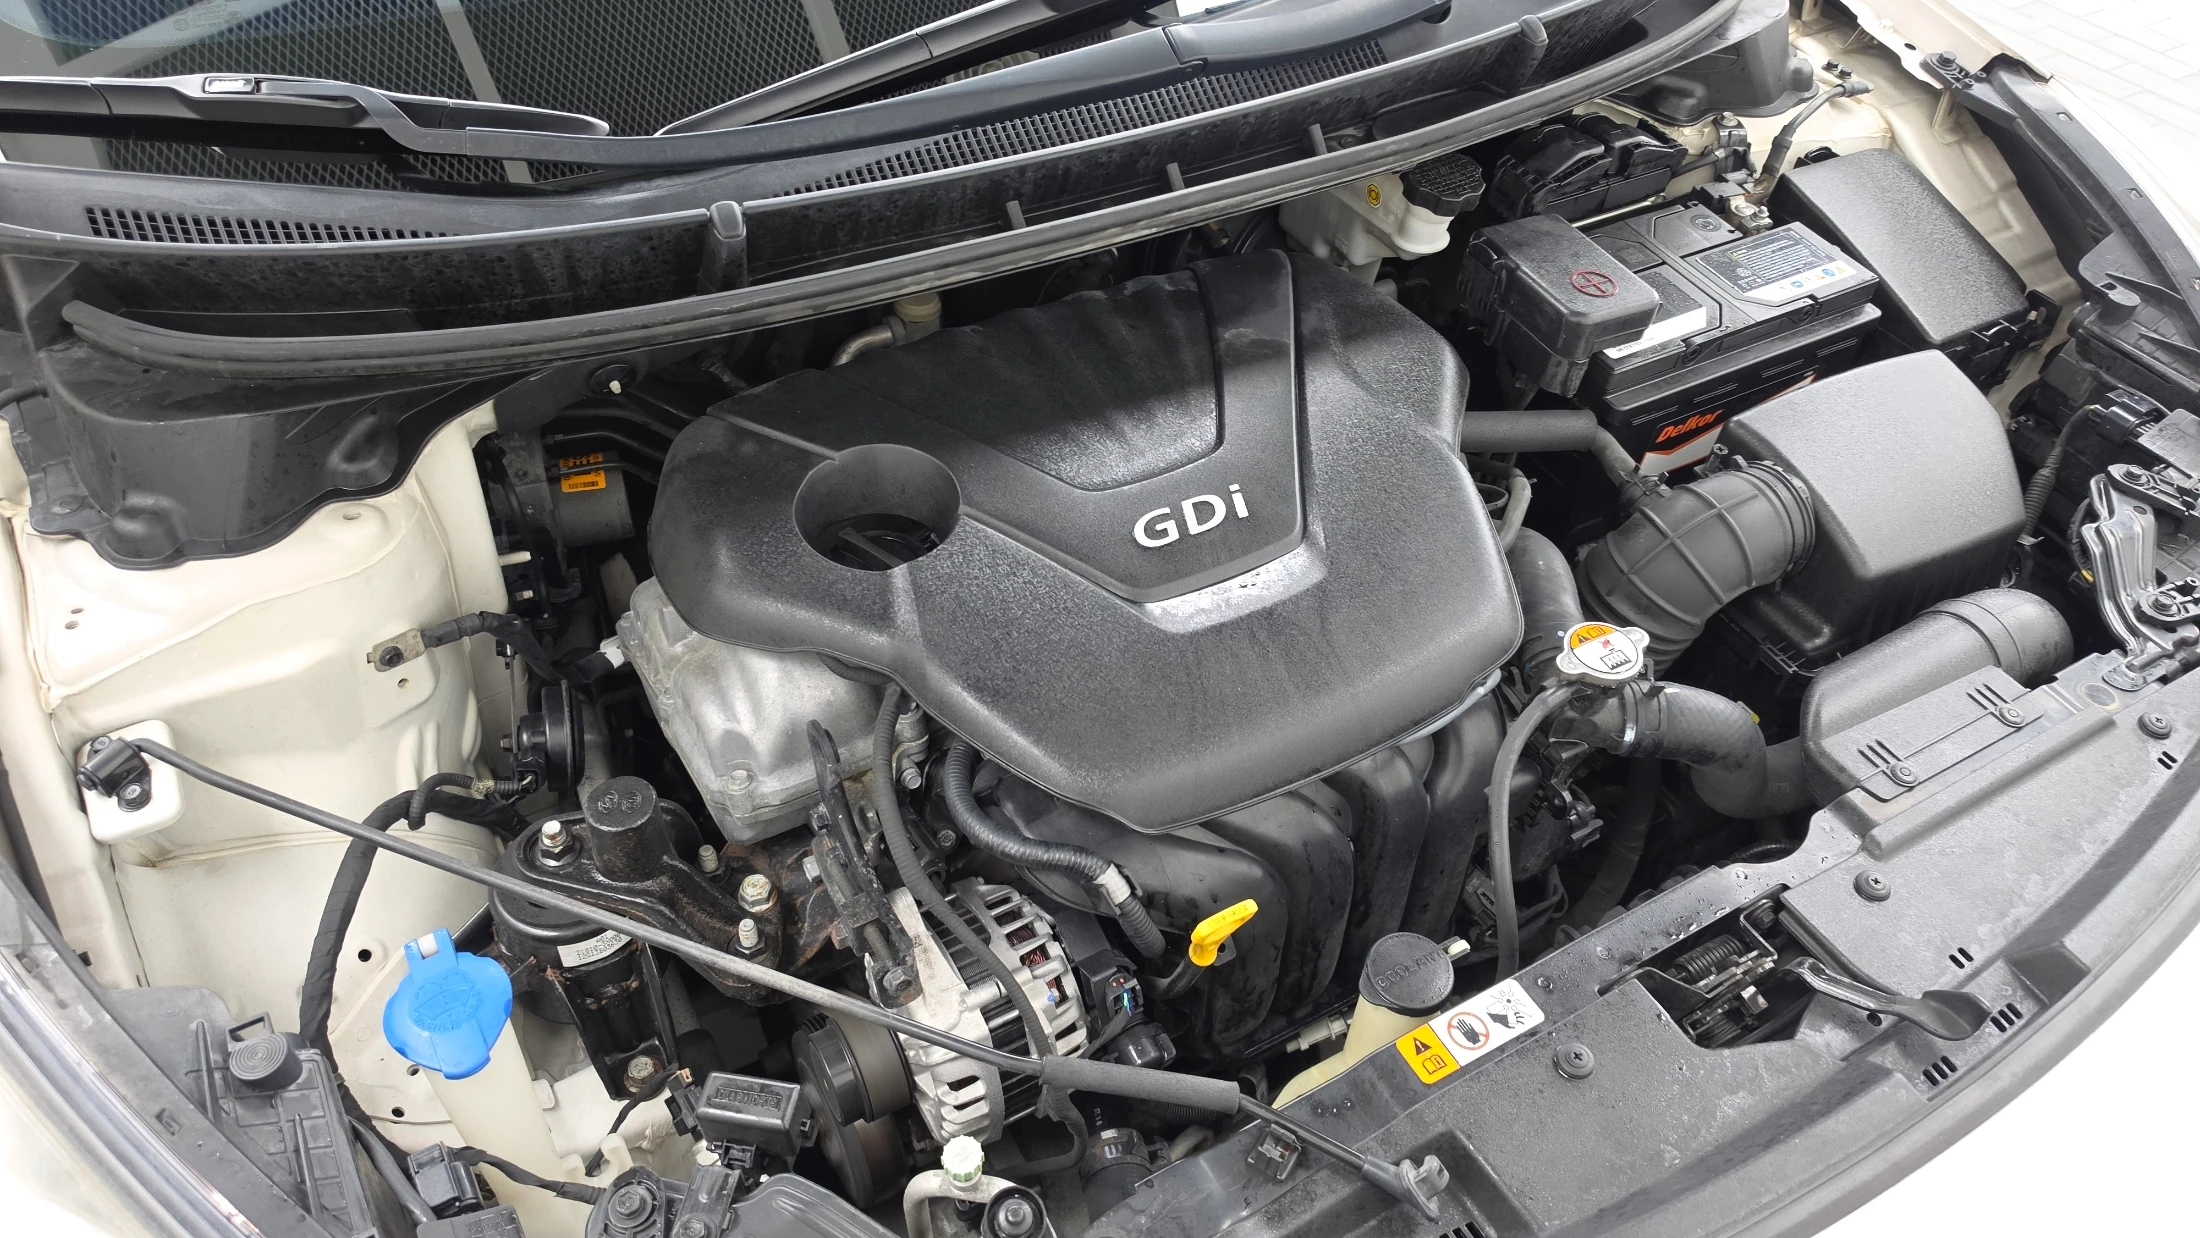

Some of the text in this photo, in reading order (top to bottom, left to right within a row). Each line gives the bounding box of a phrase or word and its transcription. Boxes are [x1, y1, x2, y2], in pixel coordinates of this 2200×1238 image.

[1655, 409, 1725, 443] Delkor
[1133, 483, 1249, 548] GDi
[1375, 951, 1444, 989] COOLANT
